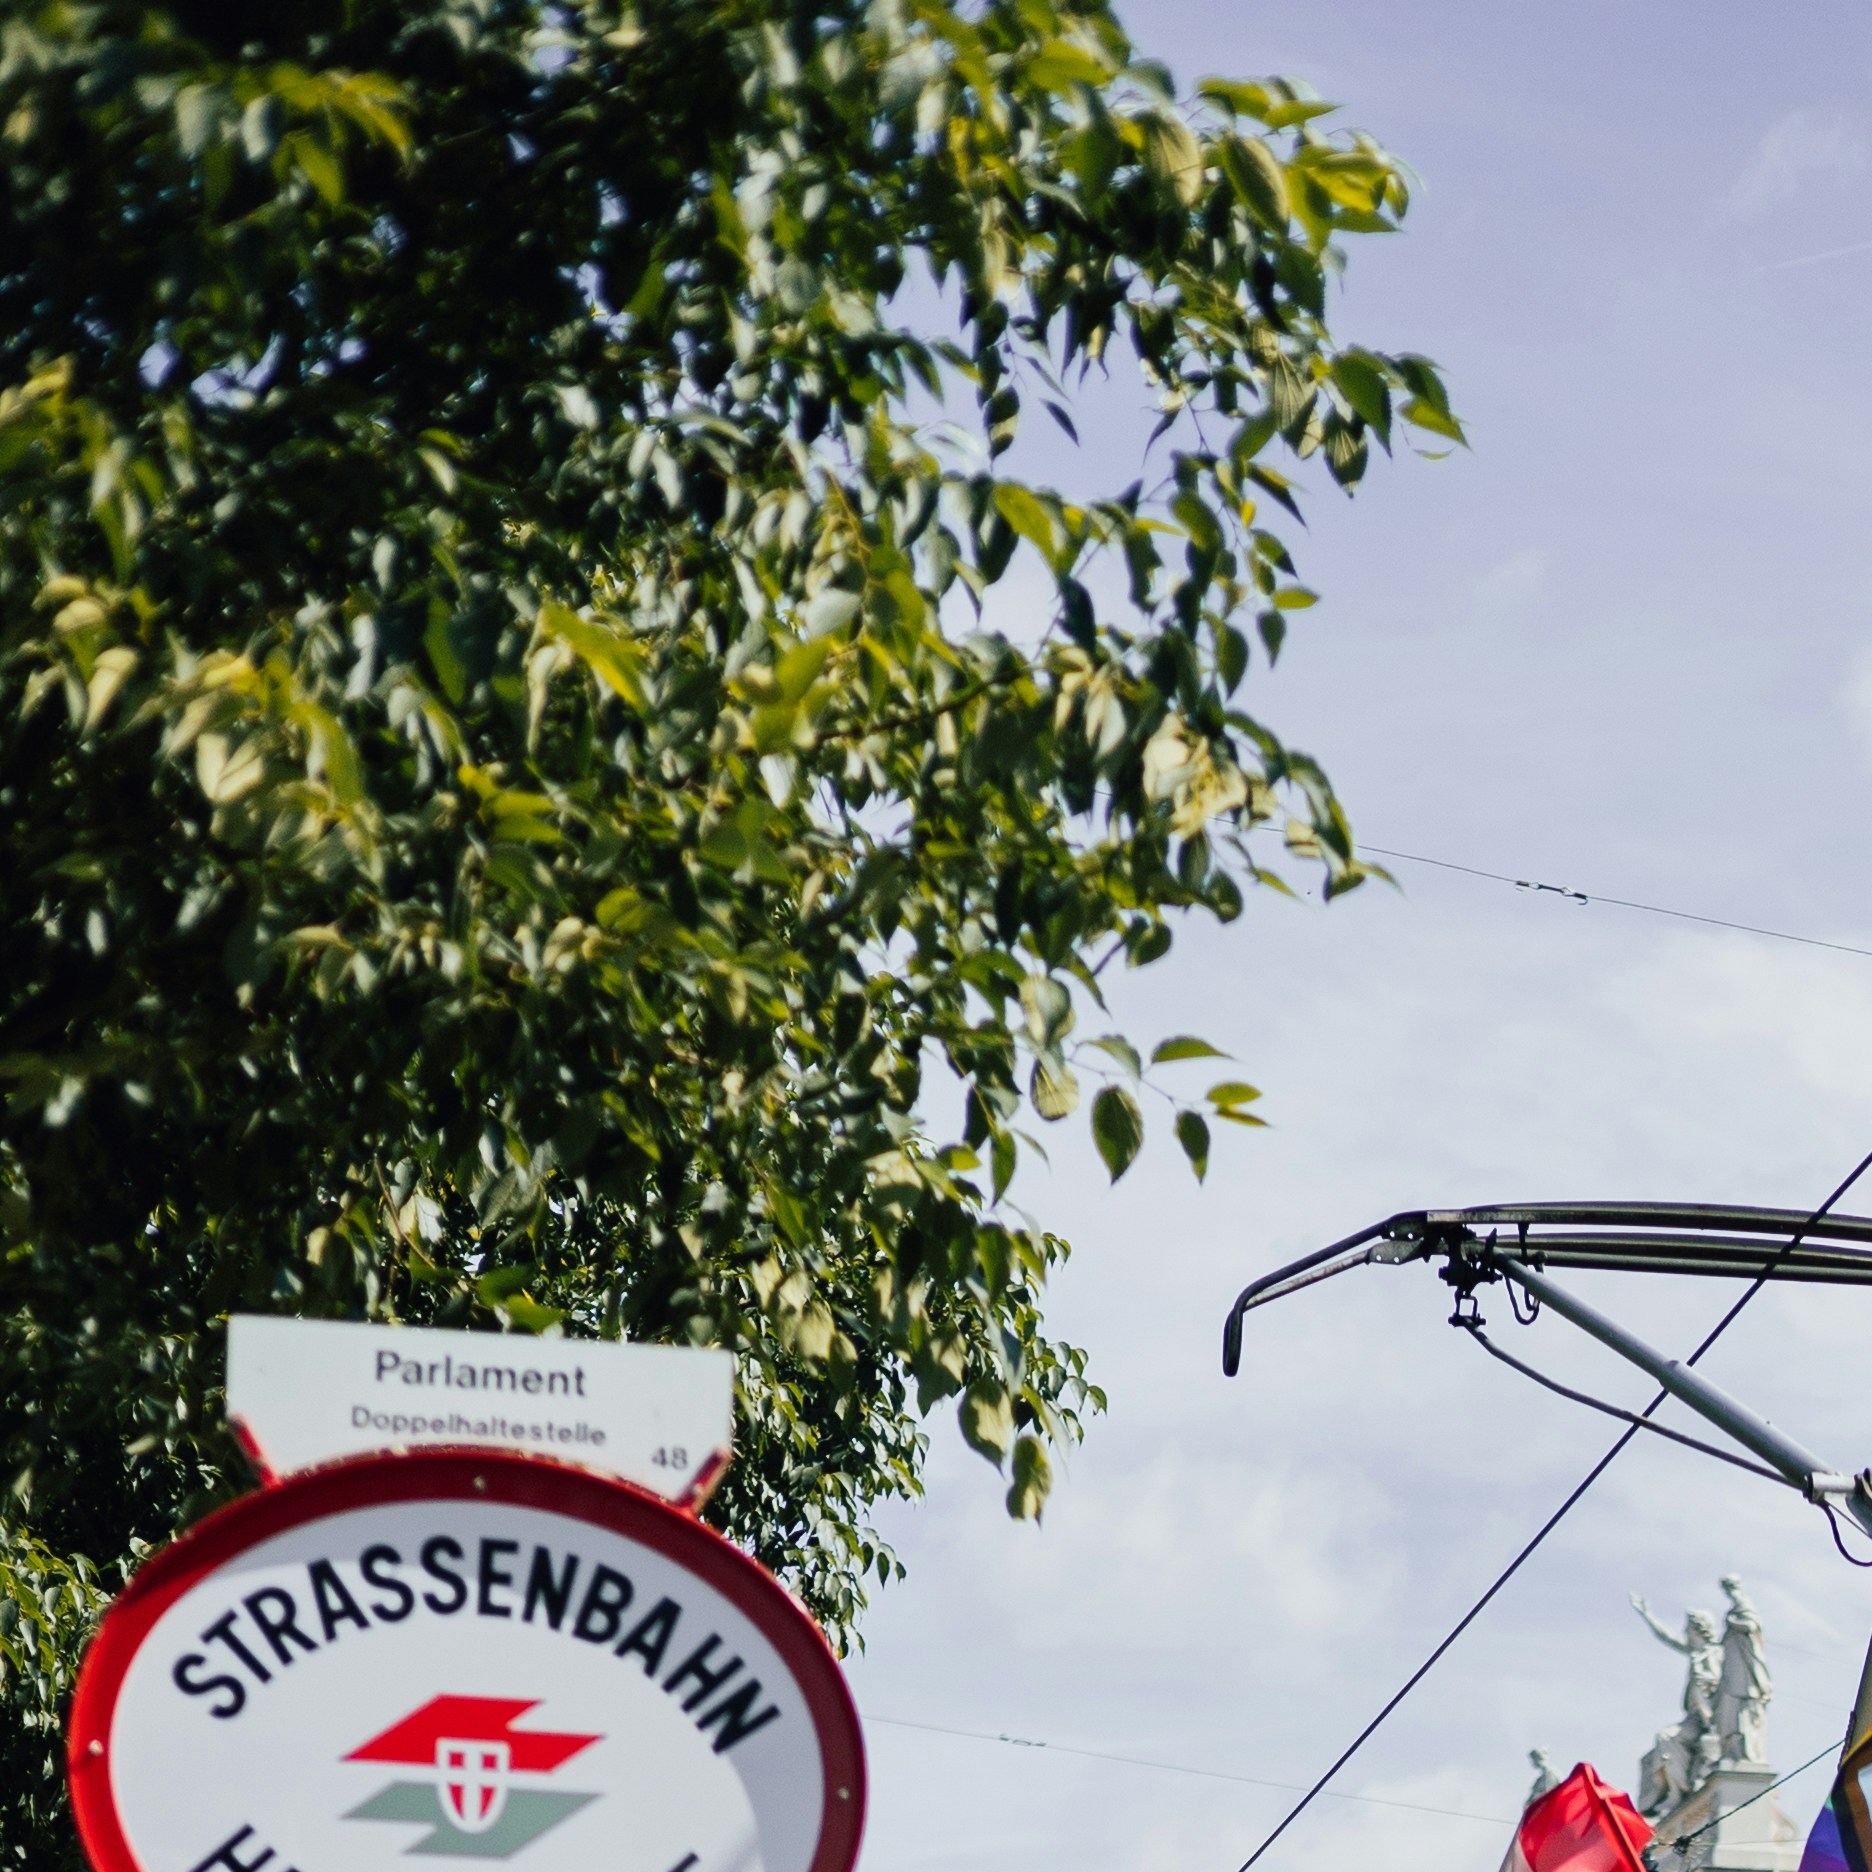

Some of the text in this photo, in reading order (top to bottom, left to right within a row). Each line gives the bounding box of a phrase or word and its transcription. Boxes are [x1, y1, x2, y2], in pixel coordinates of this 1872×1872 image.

[374, 1349, 587, 1398] Parlament
[350, 1405, 607, 1447] Doppelhaltestelle
[651, 1446, 688, 1470] 48
[172, 1535, 782, 1755] STRASSENBAHN
